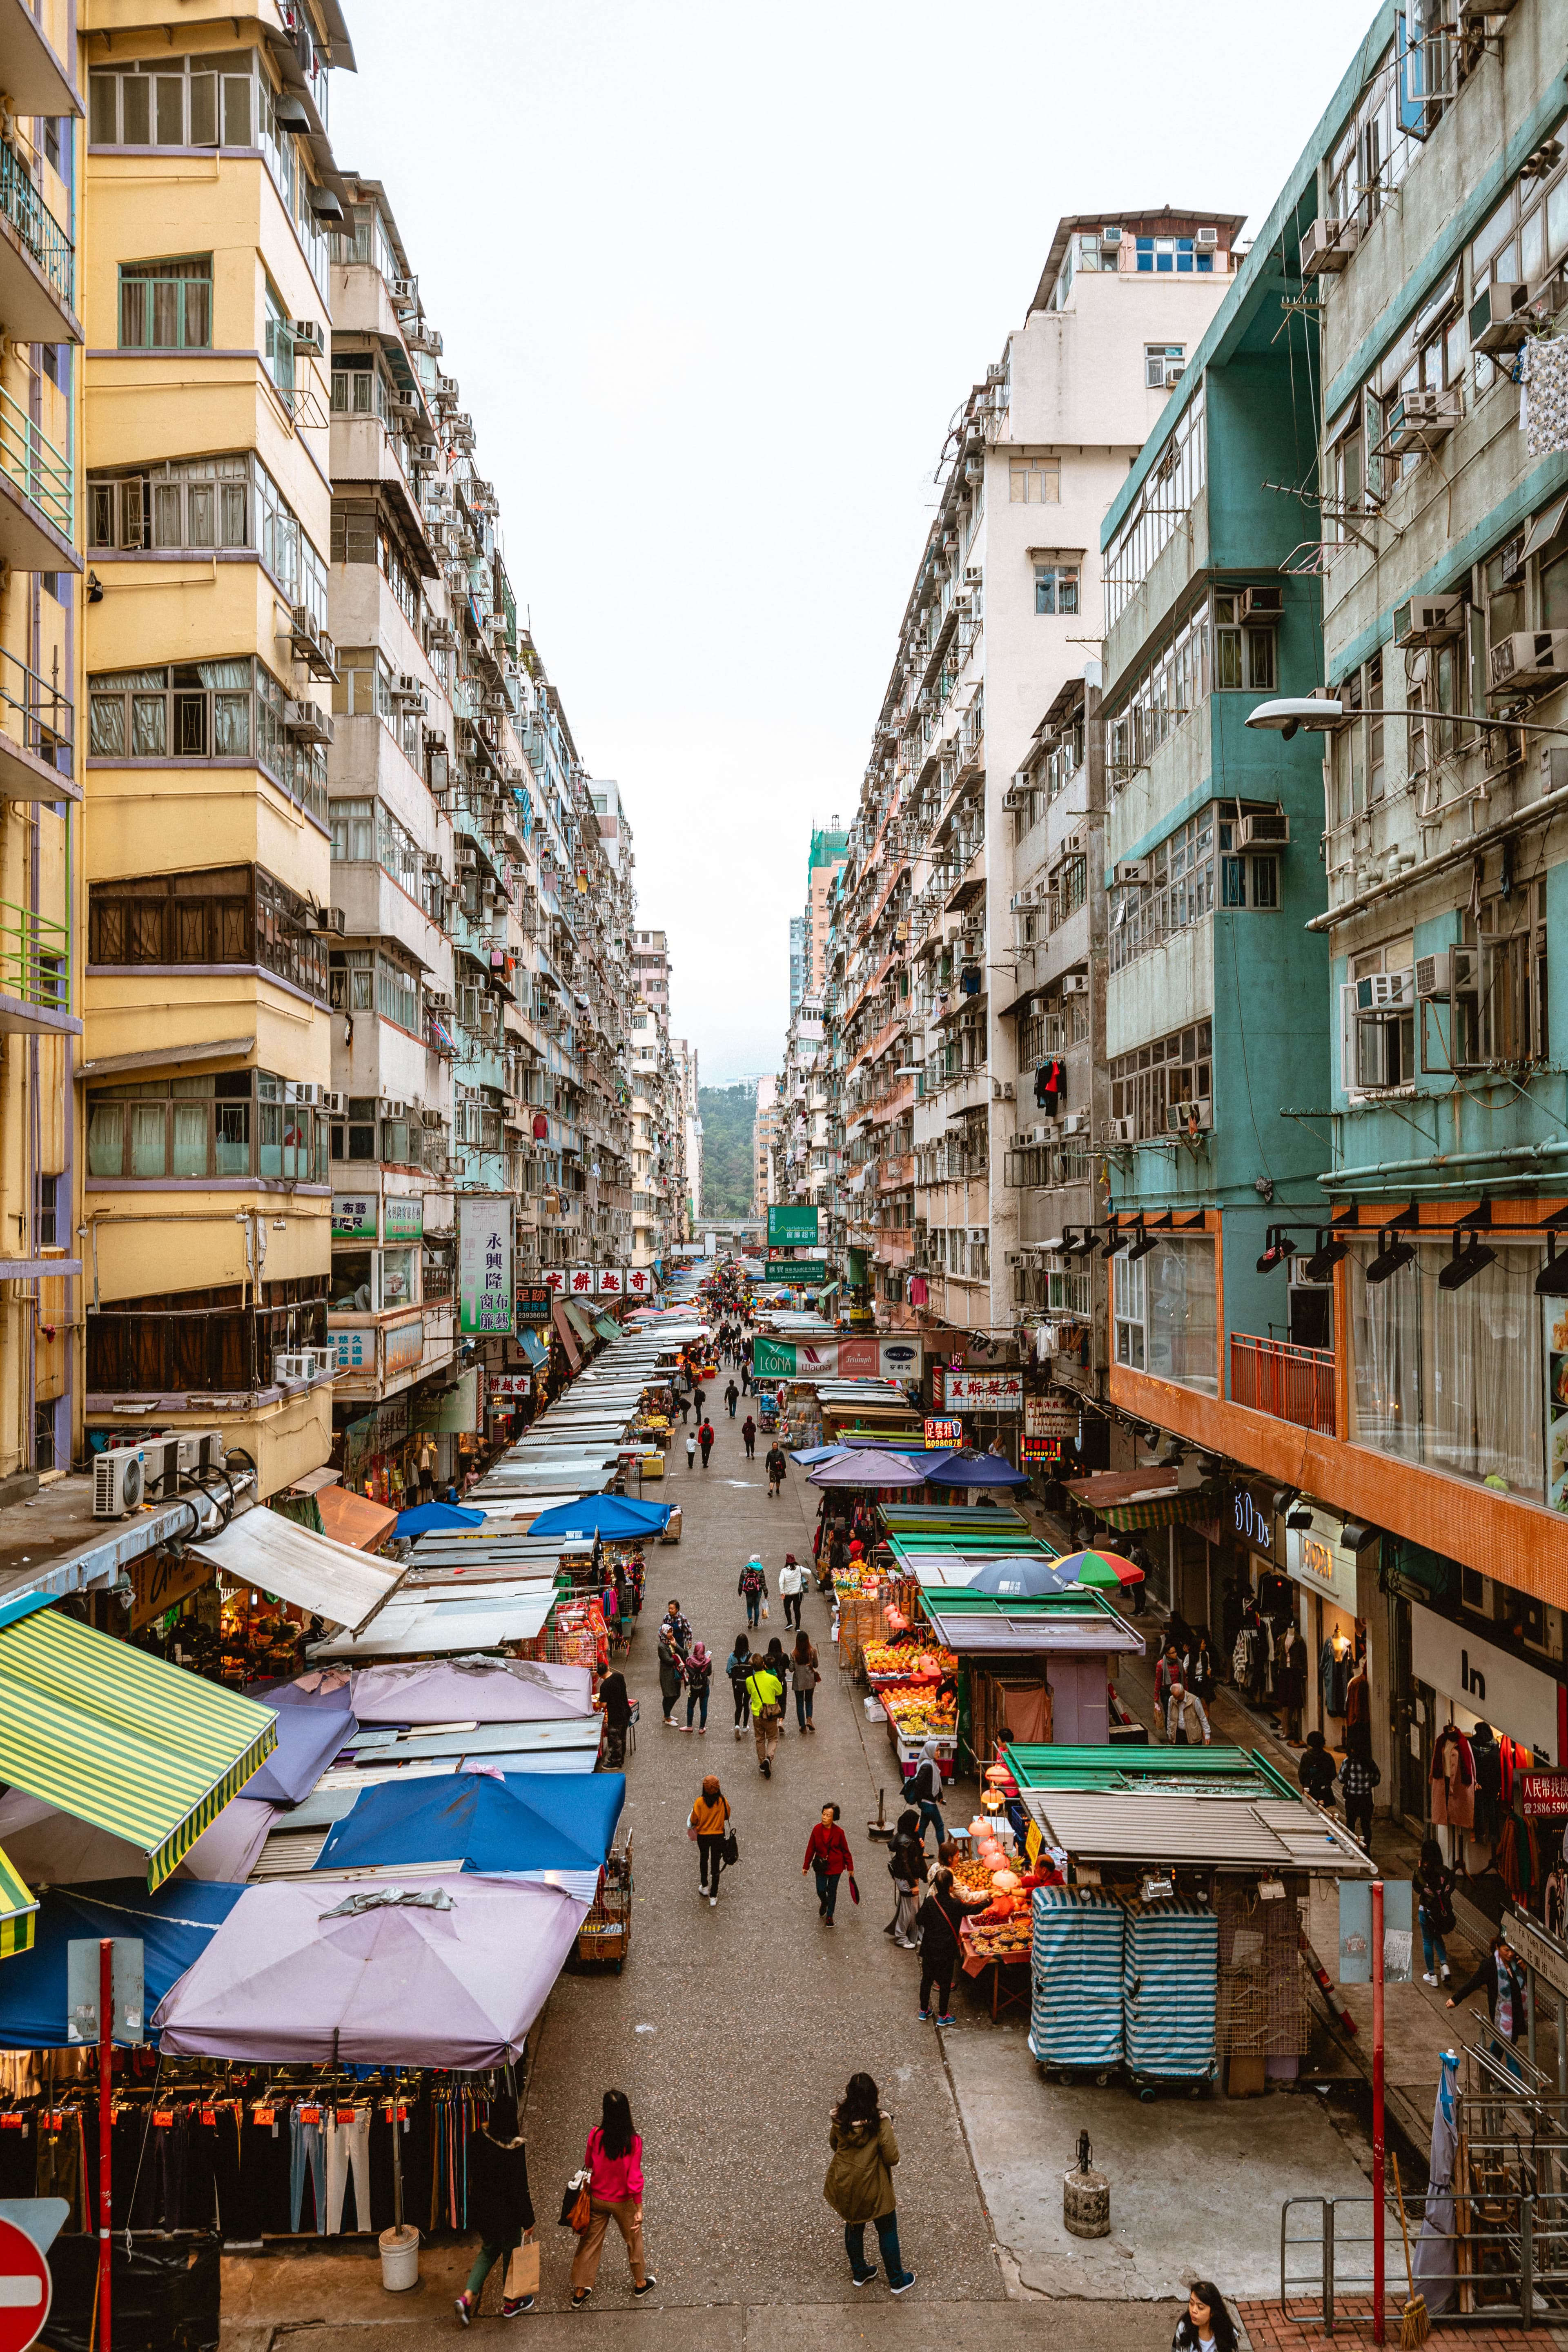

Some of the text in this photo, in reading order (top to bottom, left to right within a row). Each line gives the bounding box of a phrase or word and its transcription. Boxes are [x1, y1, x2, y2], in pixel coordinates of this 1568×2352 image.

[388, 1205, 421, 1220] 永興隆窗簾布藝
[516, 1289, 546, 1301] 足跡
[516, 1303, 548, 1311] 正宗按摩
[760, 1356, 791, 1372] LEONA
[846, 1355, 872, 1363] Triumph
[1461, 1649, 1485, 1700] In
[1533, 1802, 1550, 1813] 2886
[1518, 1924, 1556, 1965] Fa Yuen Street
[1527, 1948, 1548, 1976] 花園街
[260, 2113, 271, 2121] 90
